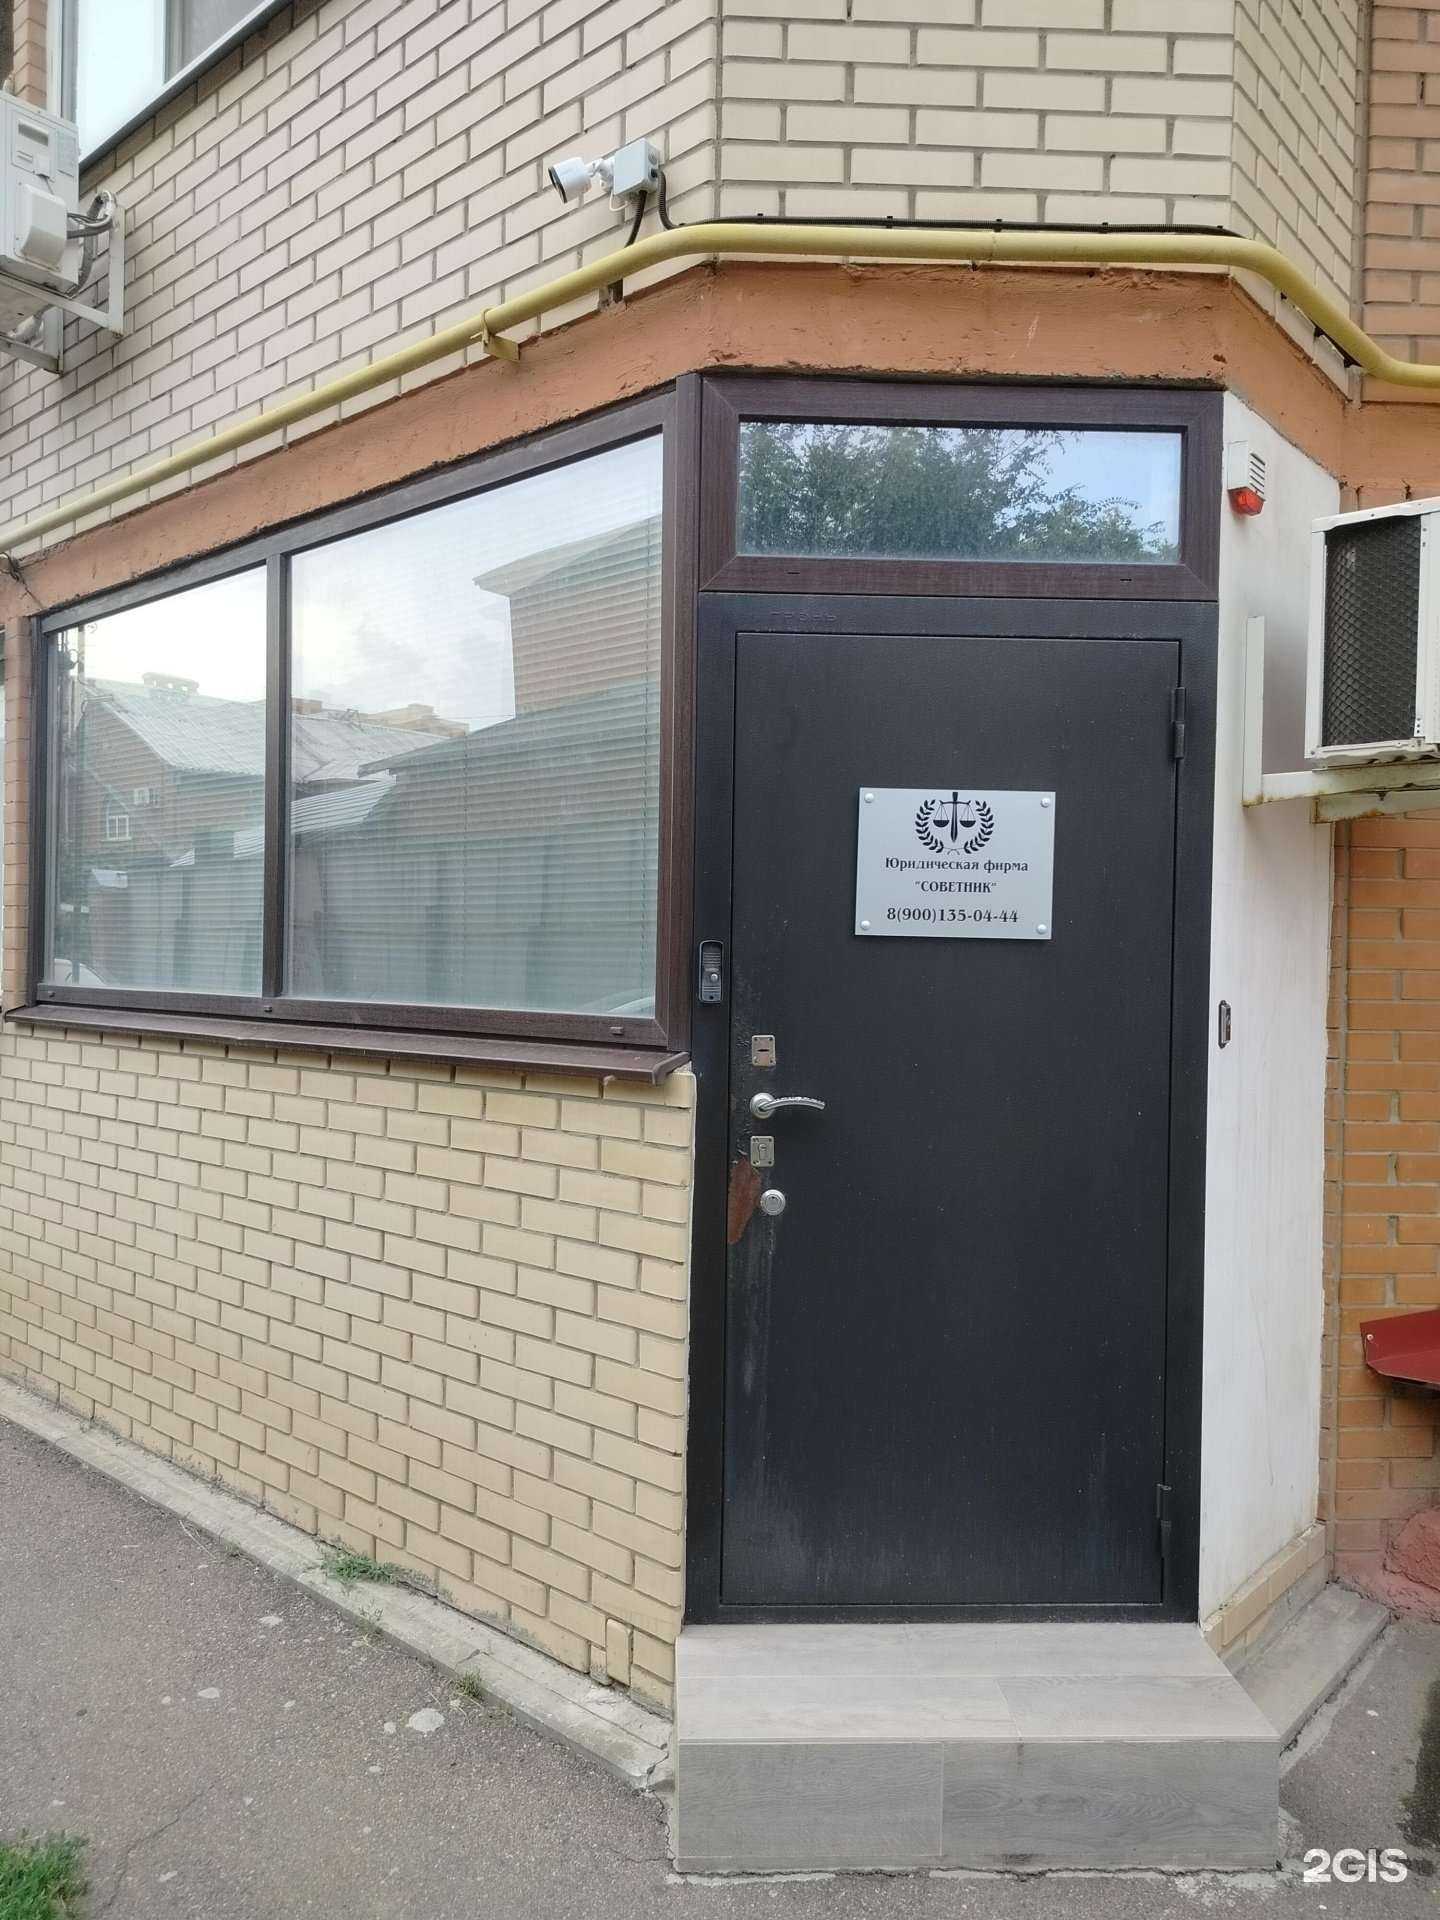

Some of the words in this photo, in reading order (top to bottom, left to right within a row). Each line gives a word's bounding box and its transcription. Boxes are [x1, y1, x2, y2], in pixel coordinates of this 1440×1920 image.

[885, 857, 979, 872] Юридическая
[984, 859, 1029, 874] фирма
[887, 907, 1019, 923] 8(900)135-04-44
